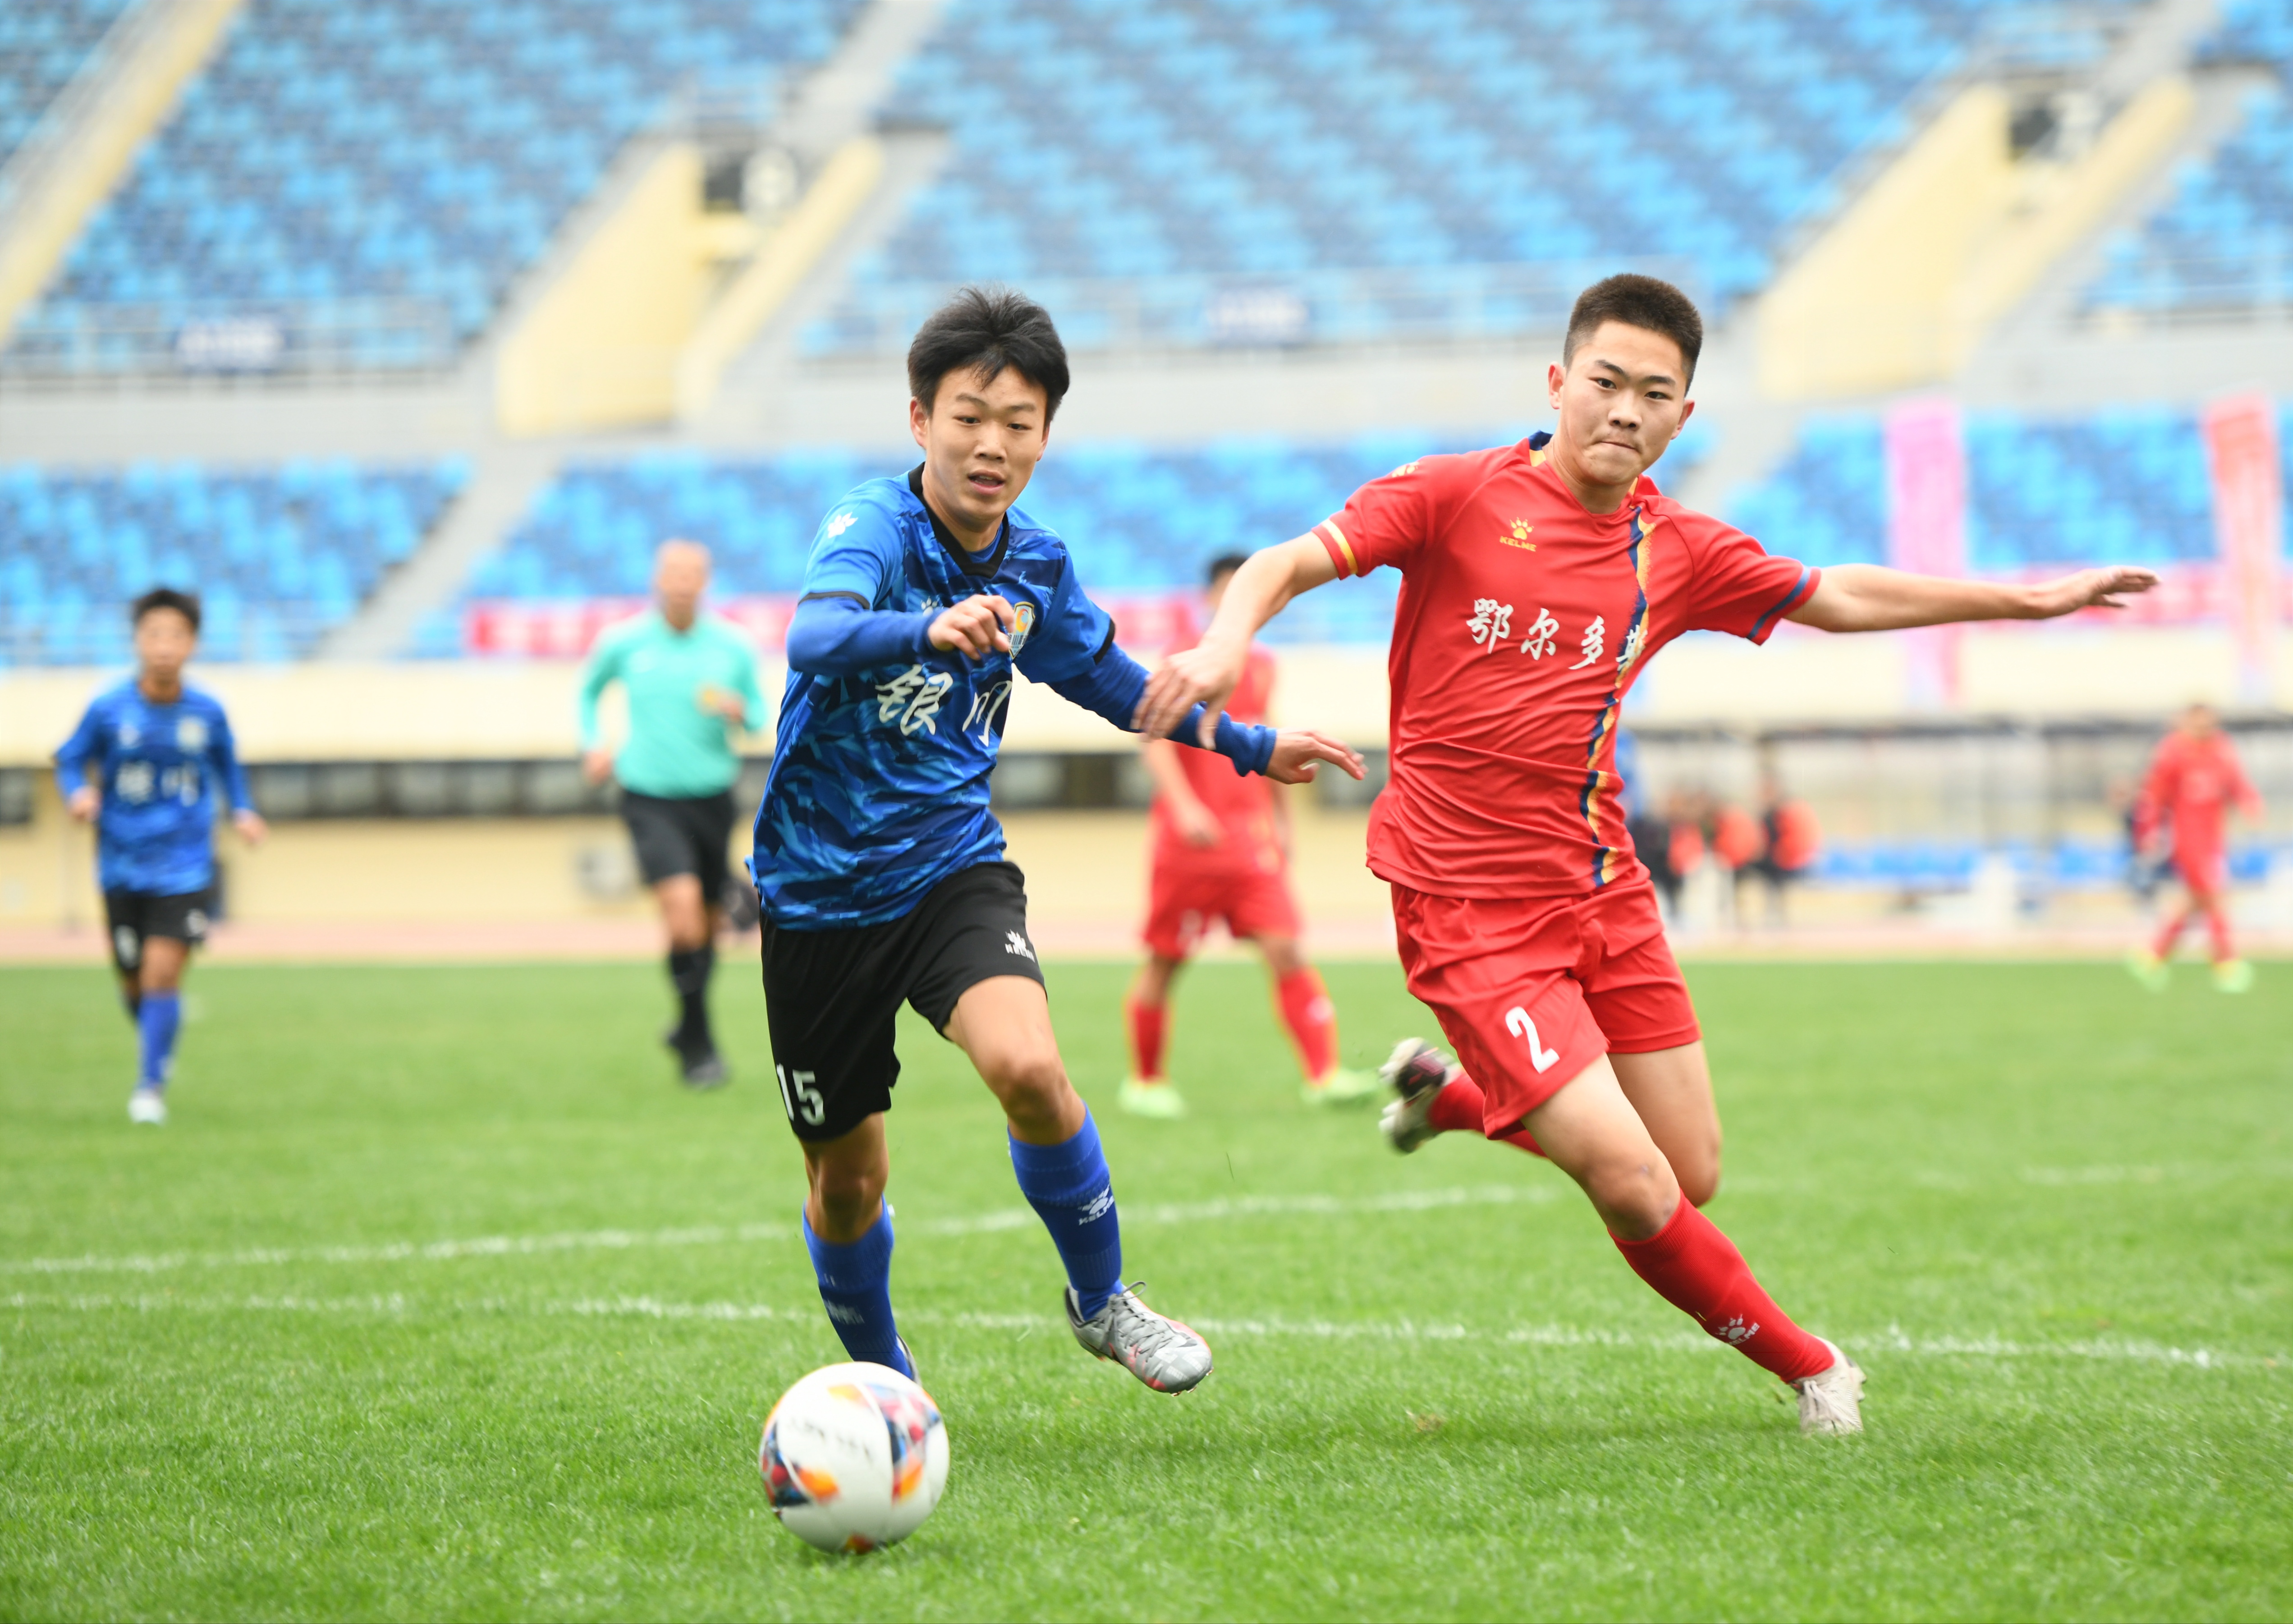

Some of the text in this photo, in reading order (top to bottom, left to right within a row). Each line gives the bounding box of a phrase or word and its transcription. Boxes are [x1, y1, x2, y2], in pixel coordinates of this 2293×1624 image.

[1500, 536, 1536, 552] KELME
[875, 664, 1013, 747] 银川
[1505, 1006, 1560, 1074] 2
[776, 1063, 825, 1126] 15
